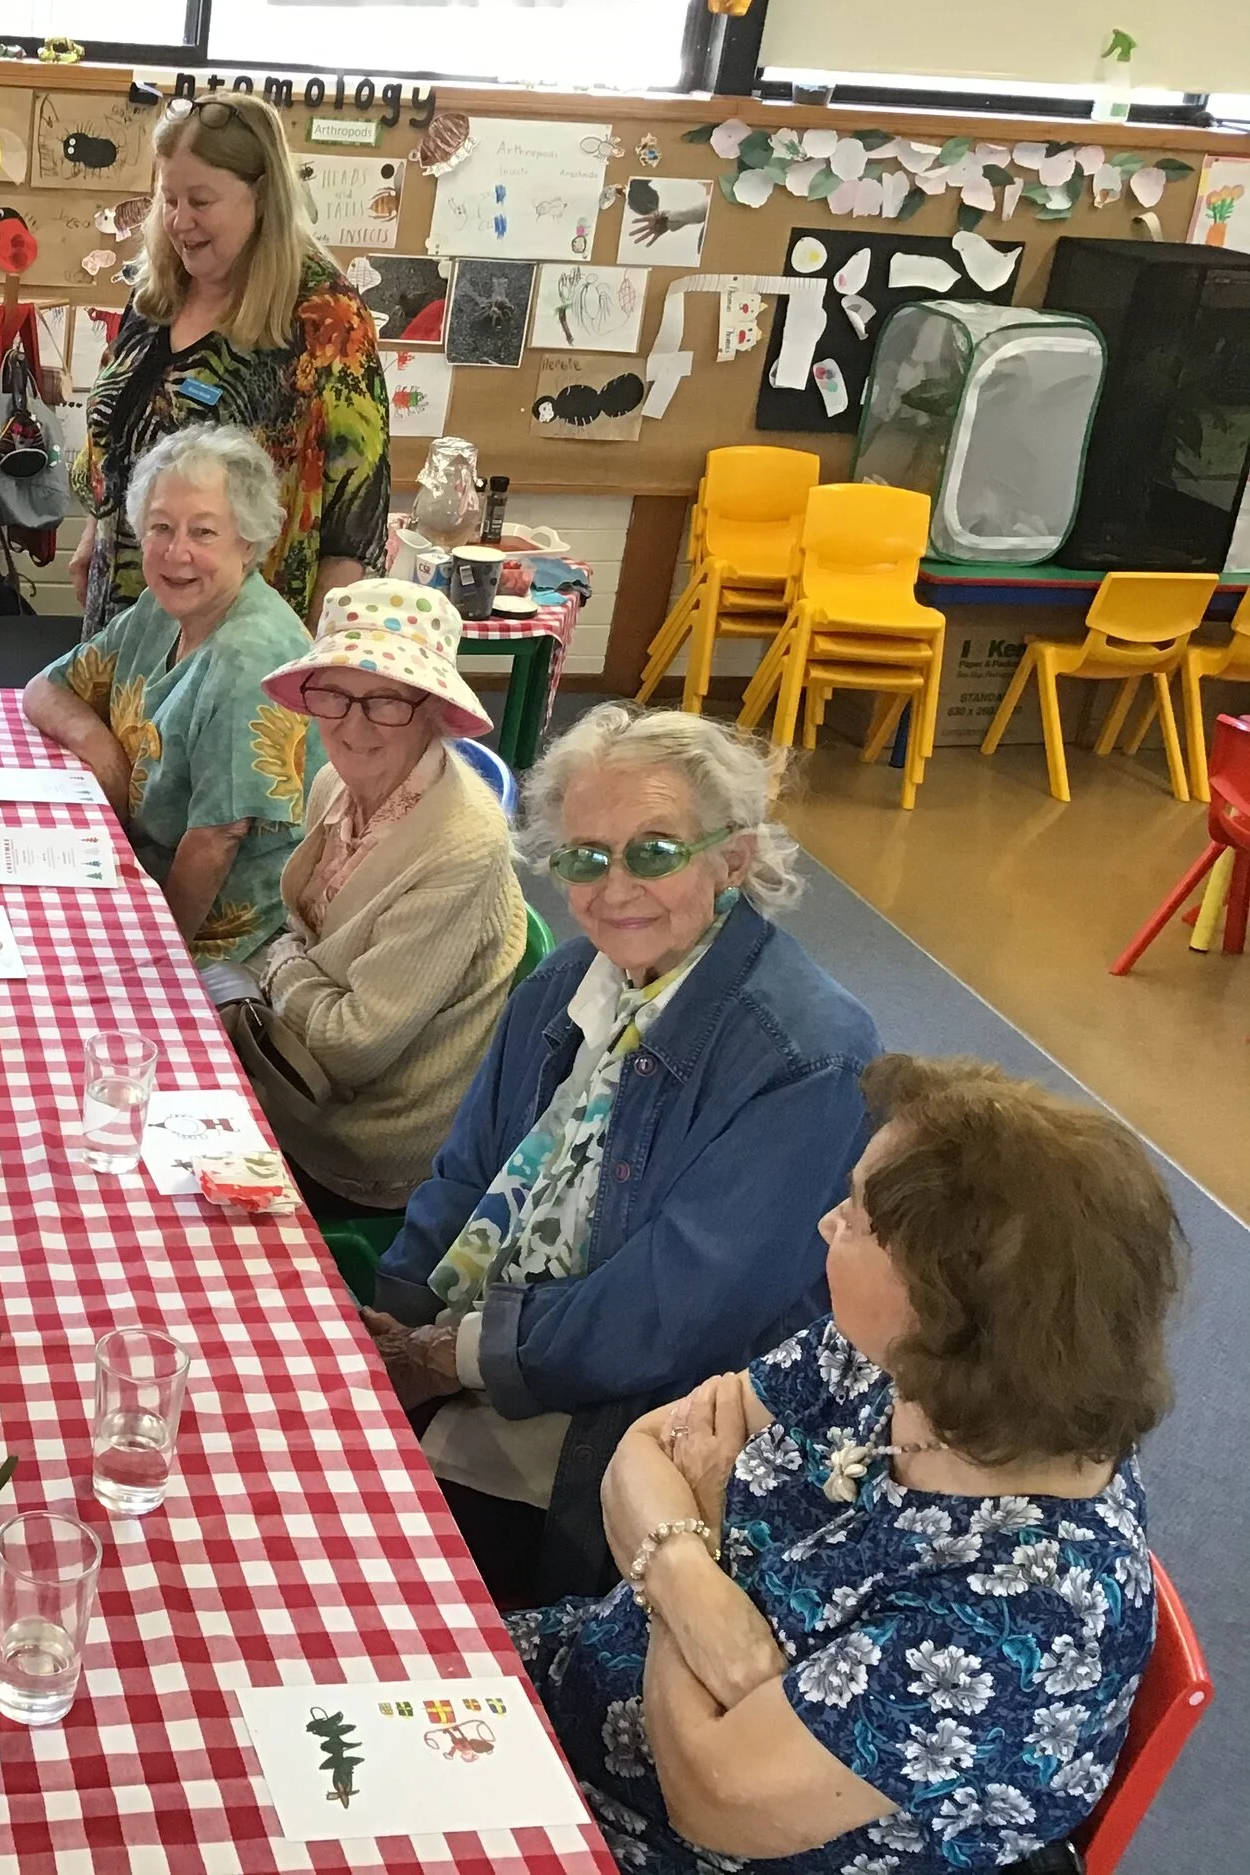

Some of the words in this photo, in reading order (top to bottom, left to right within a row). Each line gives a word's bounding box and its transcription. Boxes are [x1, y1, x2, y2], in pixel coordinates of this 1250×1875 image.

[314, 124, 374, 140] Arthropods
[321, 168, 368, 189] HEADS
[418, 563, 431, 574] CSR
